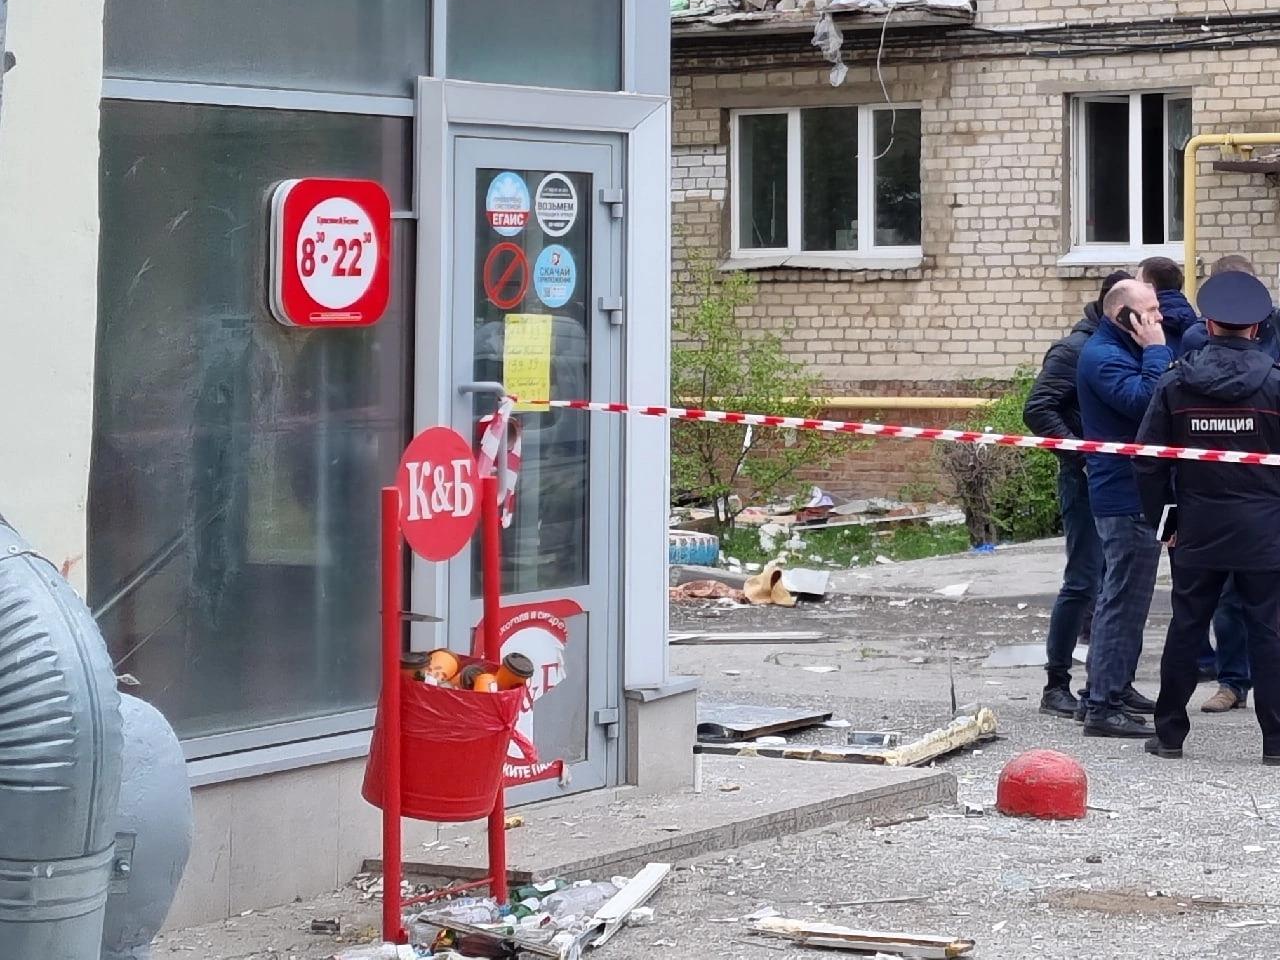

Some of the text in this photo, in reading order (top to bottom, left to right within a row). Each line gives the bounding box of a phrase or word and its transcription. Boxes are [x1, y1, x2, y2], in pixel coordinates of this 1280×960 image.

[537, 202, 574, 211] ВОЗЬМЕМ
[492, 213, 524, 226] ЕГАИС
[539, 266, 570, 276] СКАЧАЙ
[1191, 418, 1254, 433] ПОЛИЦИЯ
[406, 459, 475, 522] К&Б
